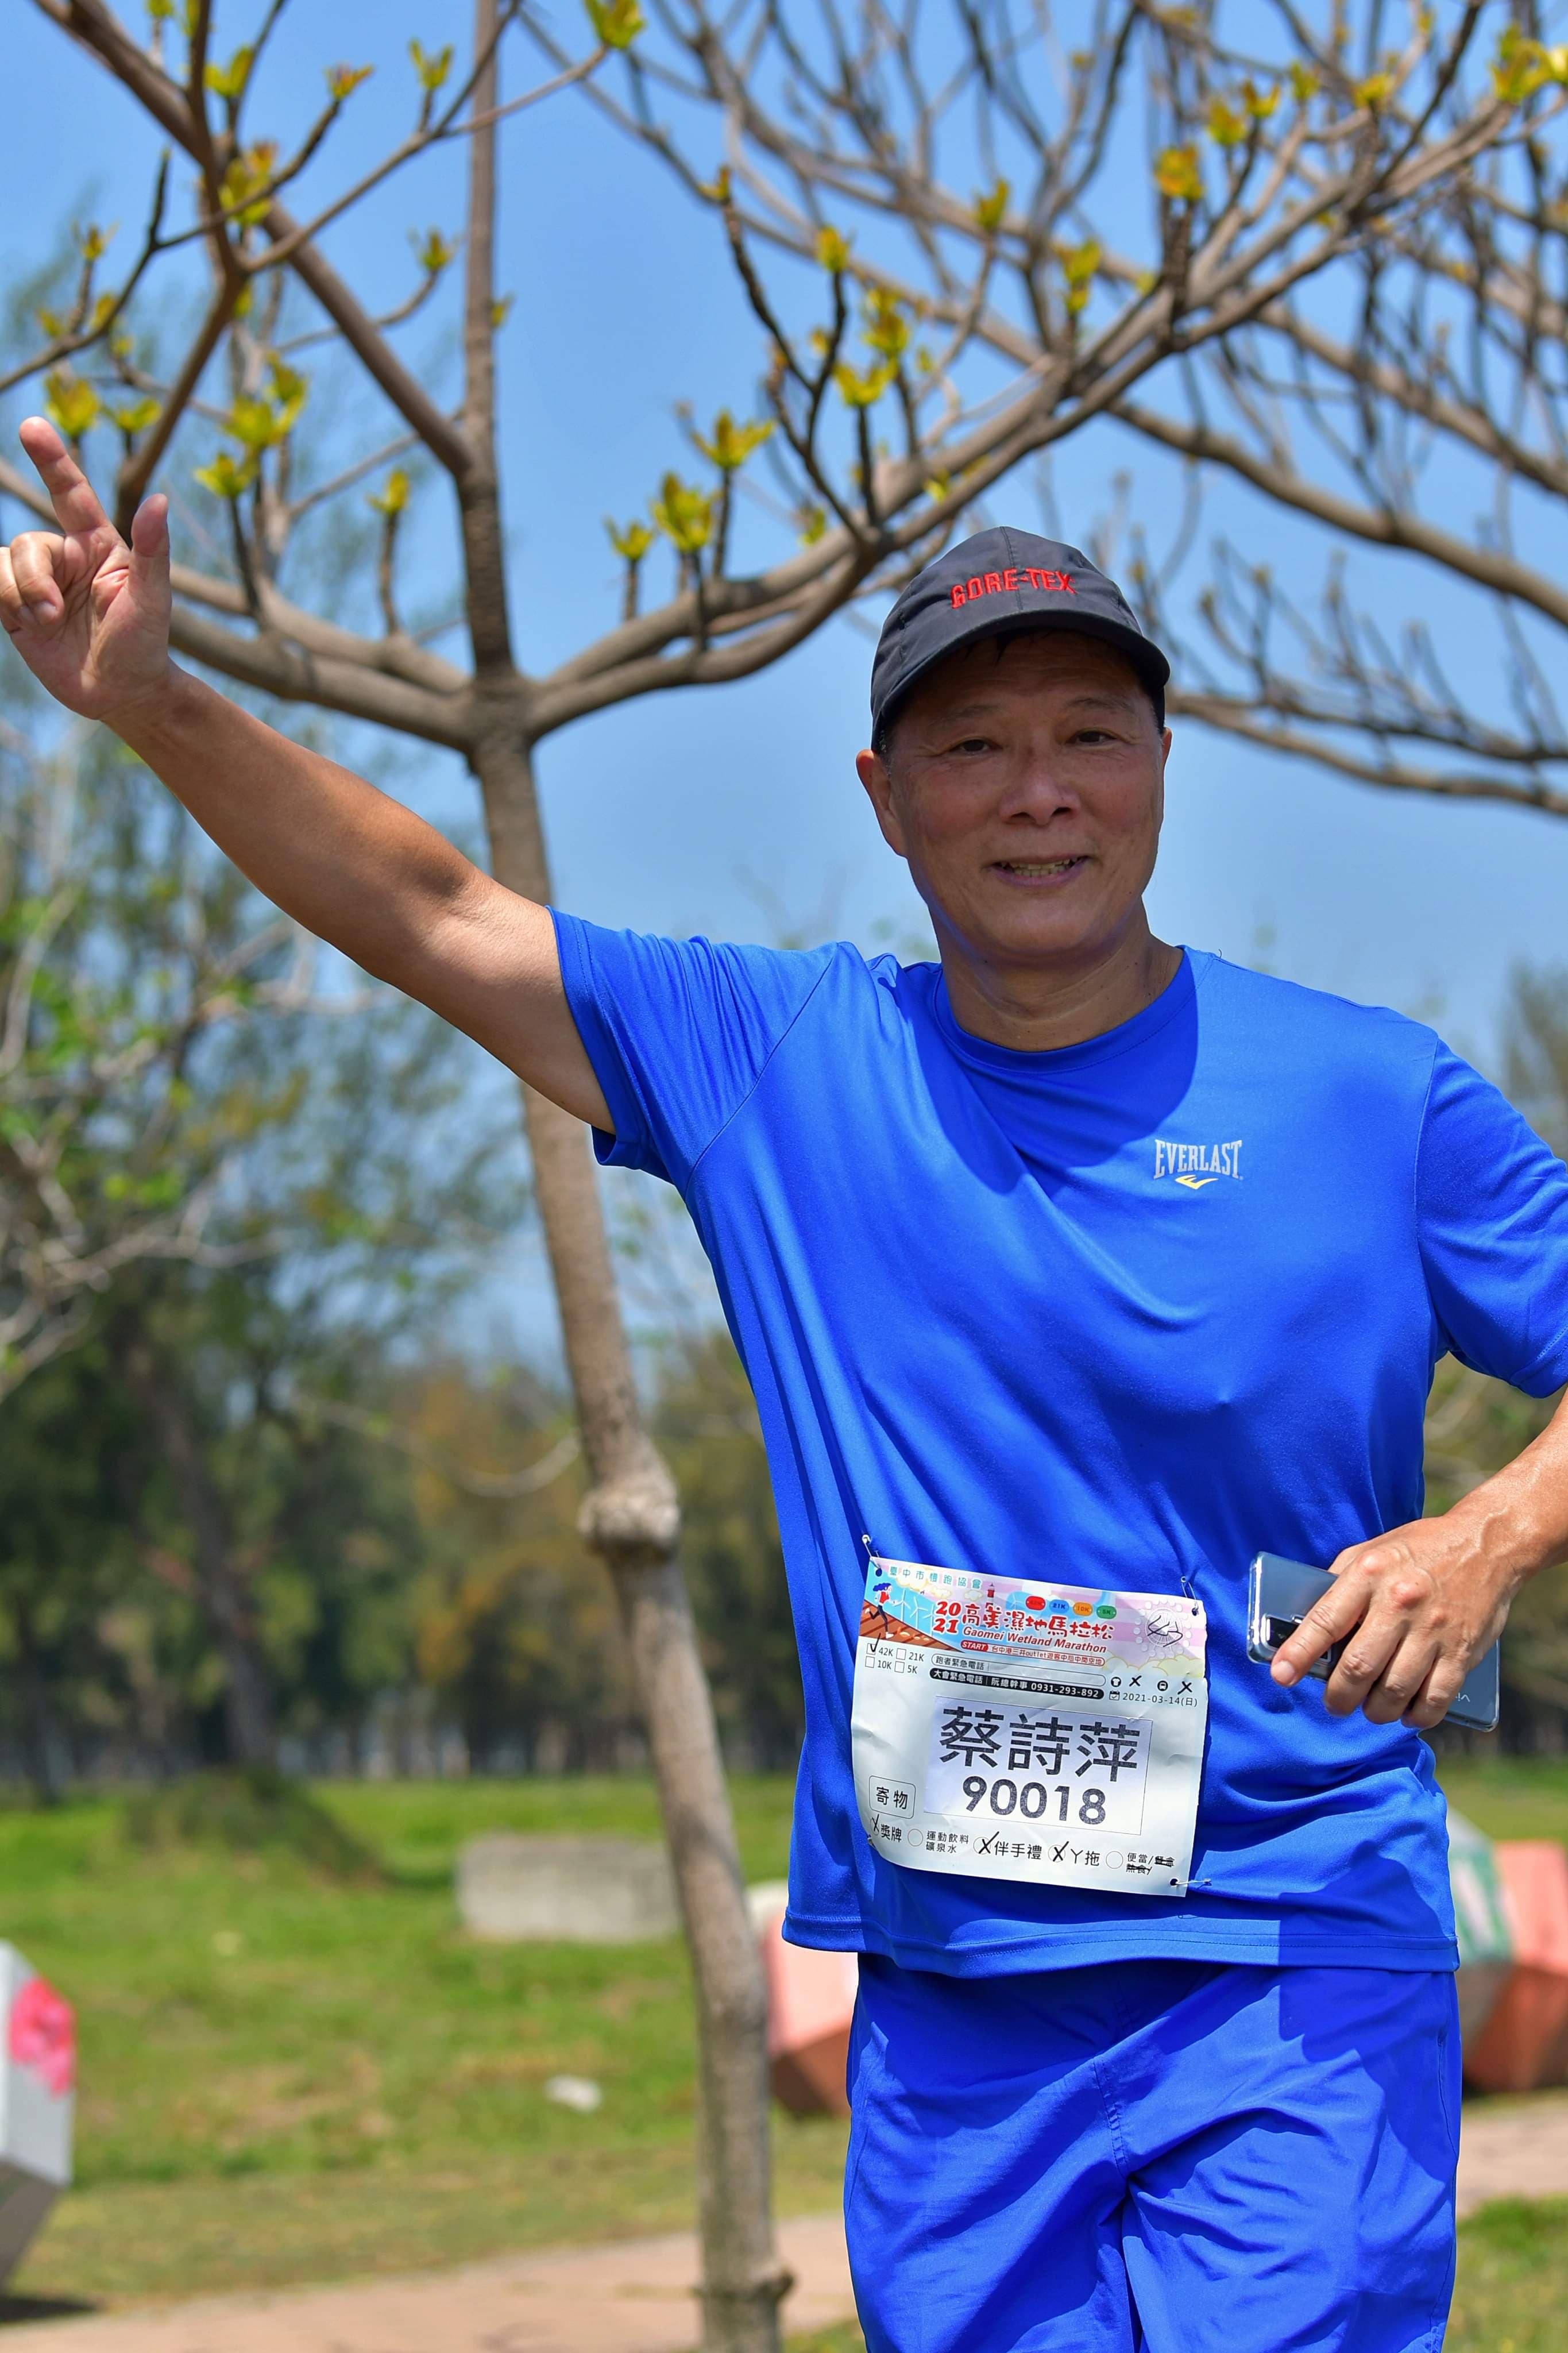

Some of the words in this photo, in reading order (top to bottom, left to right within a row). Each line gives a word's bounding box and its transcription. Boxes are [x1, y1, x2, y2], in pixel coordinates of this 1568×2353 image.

[950, 568, 1077, 609] GORE-TEX
[1153, 1139, 1243, 1180] EVERLAST
[936, 1601, 961, 1616] 20
[933, 1618, 959, 1634] 21
[962, 1603, 1114, 1640] 高美濕地馬拉松
[961, 1641, 986, 1650] START
[963, 1627, 1005, 1641] Gaomei
[1007, 1632, 1052, 1646] Wetland
[1054, 1640, 1106, 1653] Marathon
[878, 1647, 893, 1657] 42K
[909, 1652, 924, 1662] 21K
[878, 1660, 891, 1670] 10K
[907, 1665, 917, 1674] 5K
[935, 1656, 984, 1670] 跑者緊急電話
[1031, 1683, 1099, 1698] 0931-293-892
[1122, 1692, 1198, 1707] 2021-03-14(日)
[939, 1706, 1140, 1782] 蔡詩萍
[876, 1787, 909, 1810] 寄物
[963, 1776, 1106, 1825] 90018
[880, 1823, 902, 1843] 獎牌
[926, 1830, 969, 1845] 運動飲料
[926, 1841, 957, 1853] 礦泉水
[994, 1841, 1042, 1860] 伴手禮
